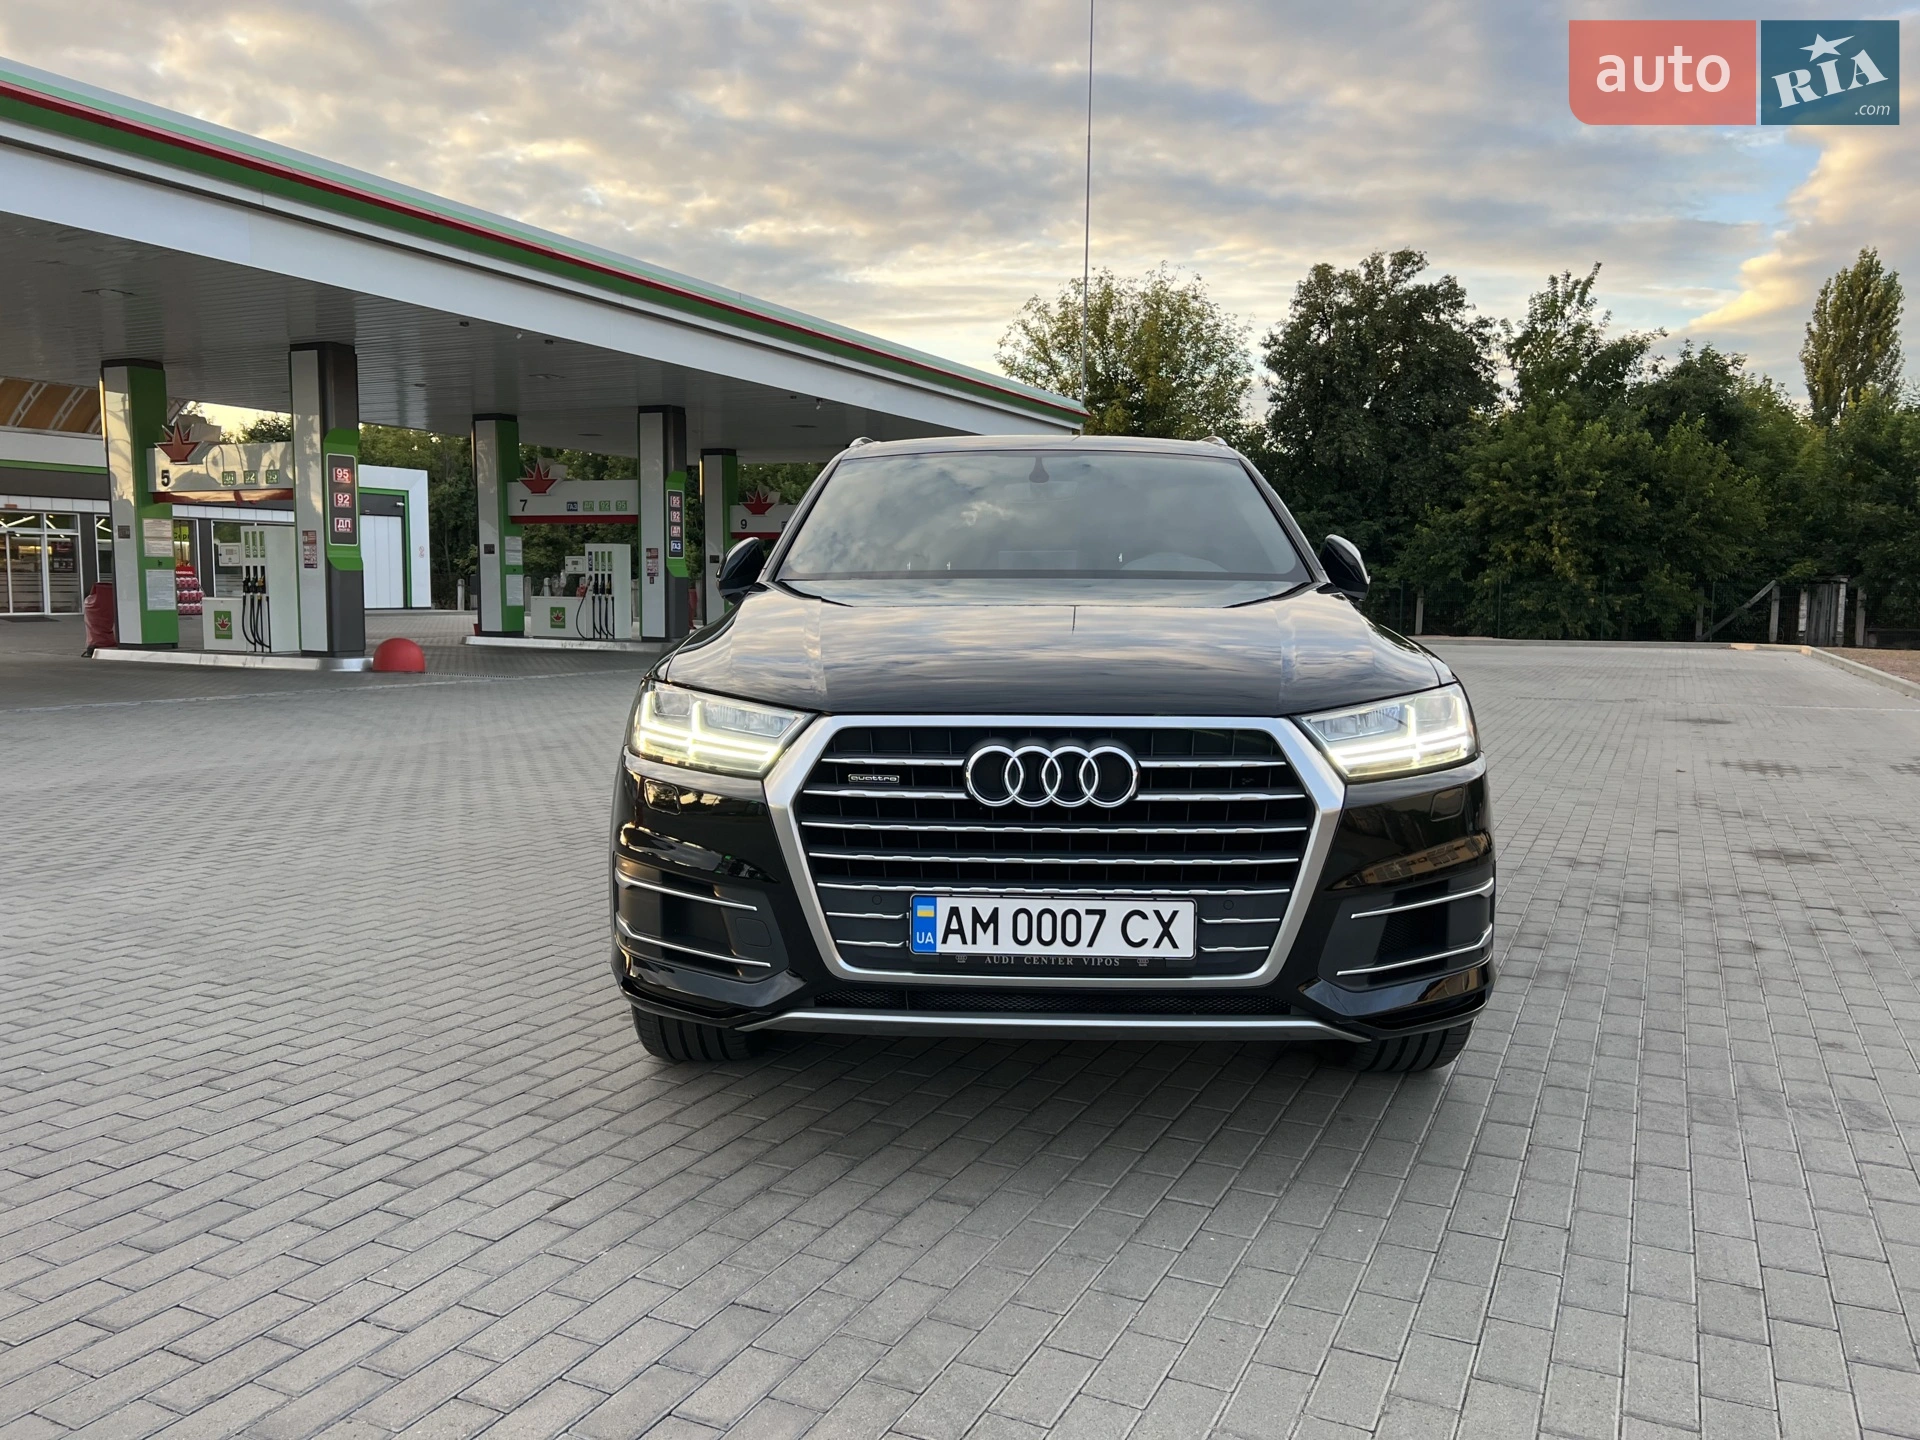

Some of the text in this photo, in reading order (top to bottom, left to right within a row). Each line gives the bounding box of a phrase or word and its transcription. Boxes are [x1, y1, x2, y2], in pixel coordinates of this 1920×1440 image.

[161, 470, 171, 487] 5
[336, 468, 349, 479] 95
[337, 494, 350, 504] 92
[519, 499, 528, 512] 7
[567, 503, 578, 511] ГАЗ
[600, 501, 610, 509] 92
[616, 501, 626, 509] 95
[337, 519, 351, 529] ДП
[740, 519, 748, 530] 9
[850, 775, 898, 783] quattro
[941, 906, 1180, 949] AM 0007 CX
[916, 931, 934, 944] UA
[984, 956, 1120, 967] AUDI CENTER VIPOS
